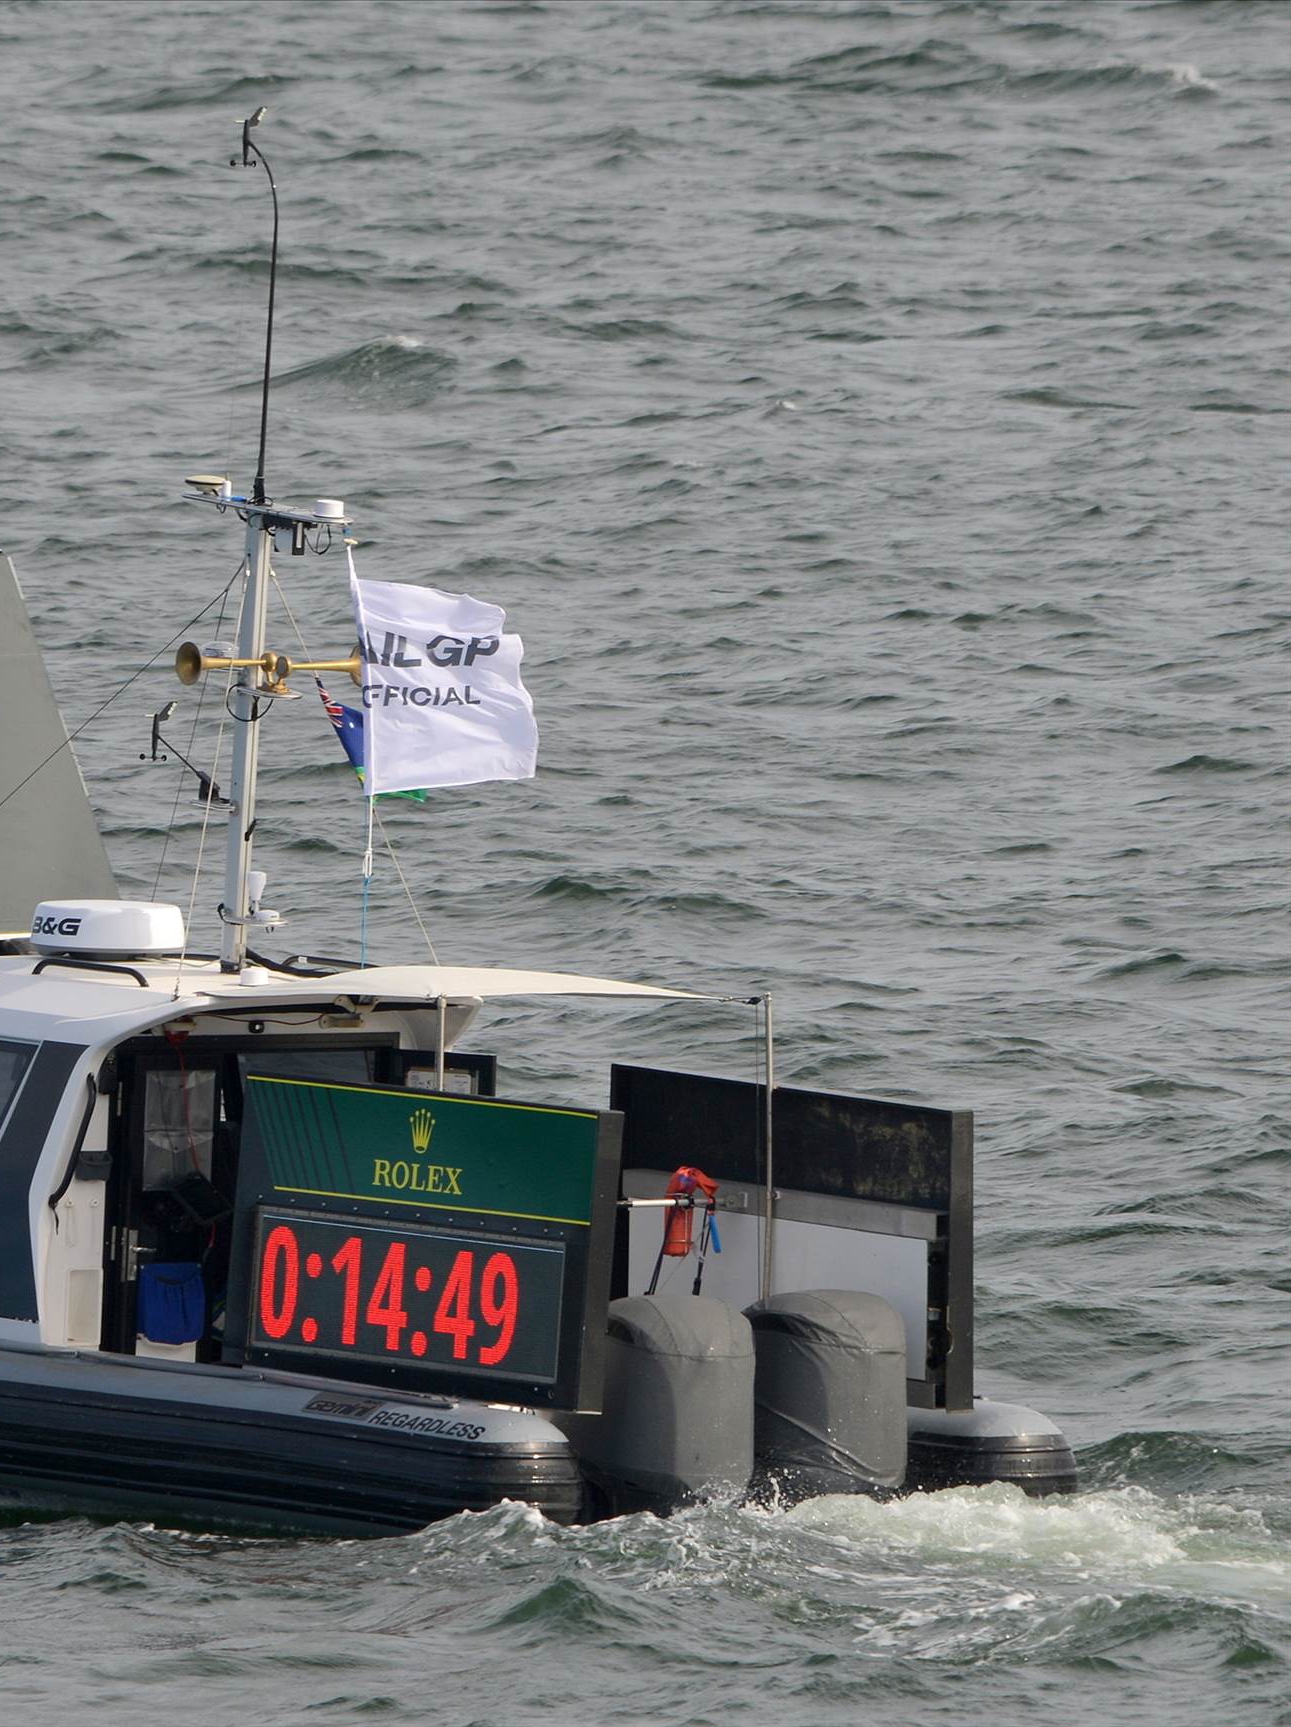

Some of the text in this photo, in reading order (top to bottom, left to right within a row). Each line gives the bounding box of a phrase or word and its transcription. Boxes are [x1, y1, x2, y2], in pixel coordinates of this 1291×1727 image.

[33, 916, 82, 936] B&G
[372, 1159, 463, 1195] ROLEX
[260, 1225, 519, 1366] 0:14:49
[368, 1410, 486, 1441] REGARDLESS
